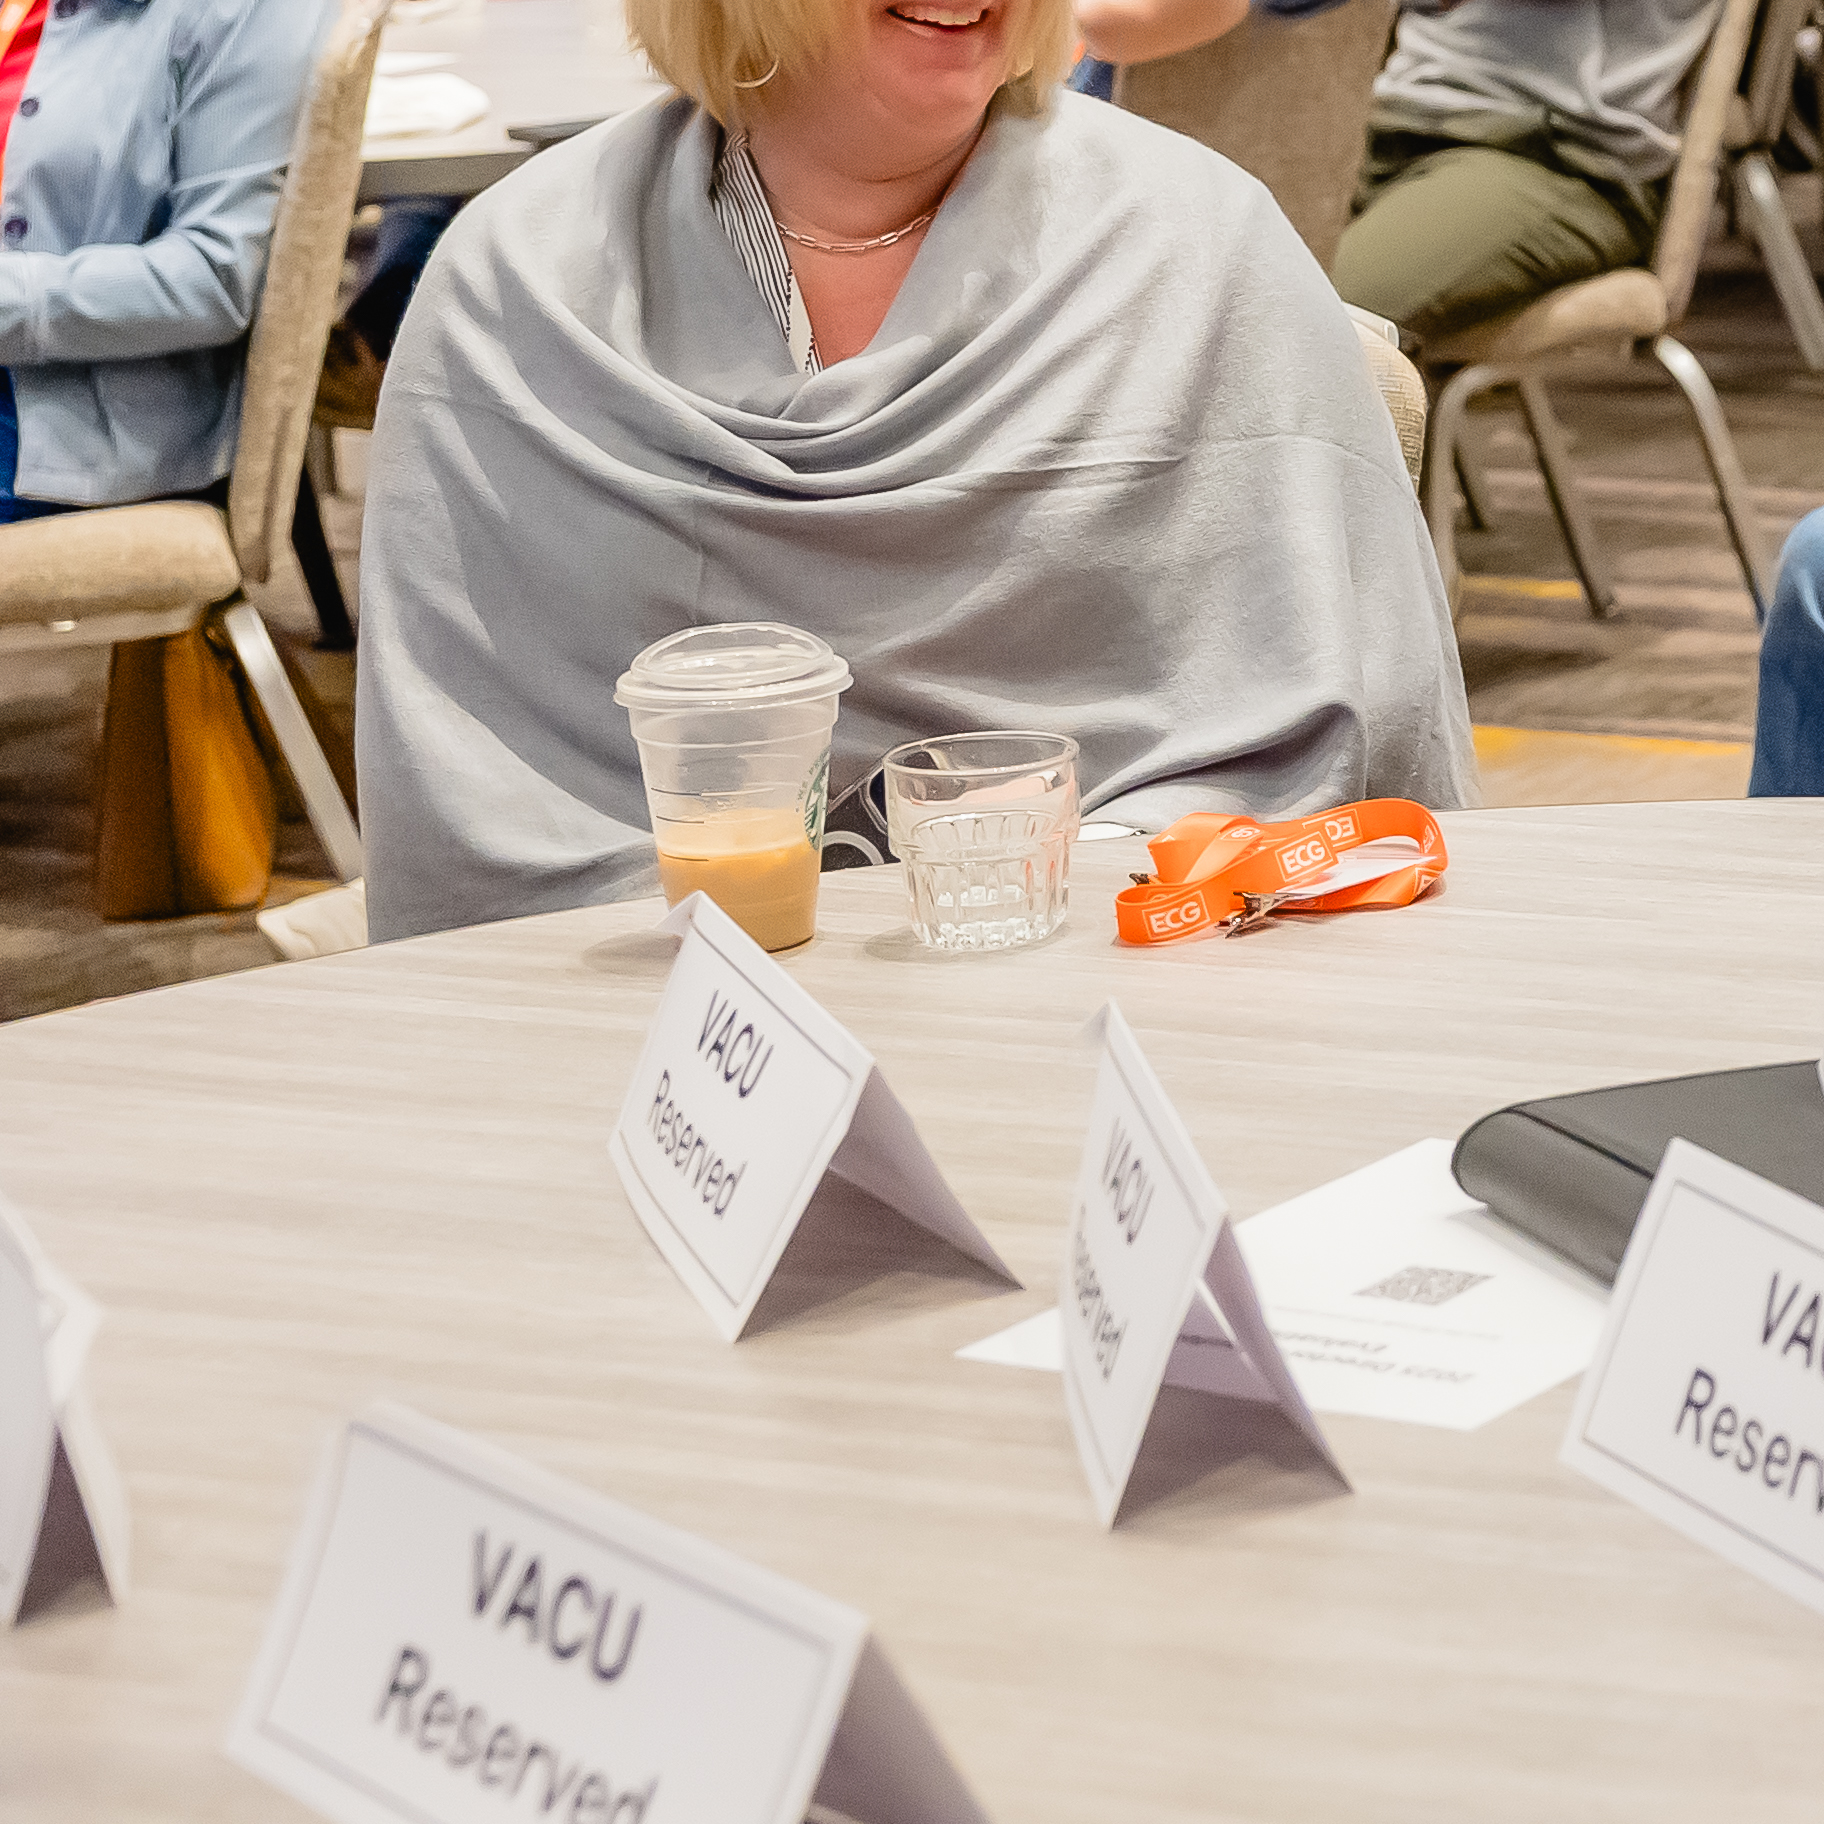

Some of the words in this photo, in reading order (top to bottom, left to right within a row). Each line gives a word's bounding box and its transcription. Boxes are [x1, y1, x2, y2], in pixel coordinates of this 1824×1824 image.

[1149, 900, 1201, 934] ECG
[1281, 840, 1326, 874] ECG
[697, 988, 774, 1099] VACU
[648, 1068, 748, 1219] Reserved
[1102, 1116, 1156, 1246] VACU
[470, 1527, 644, 1684] VACU
